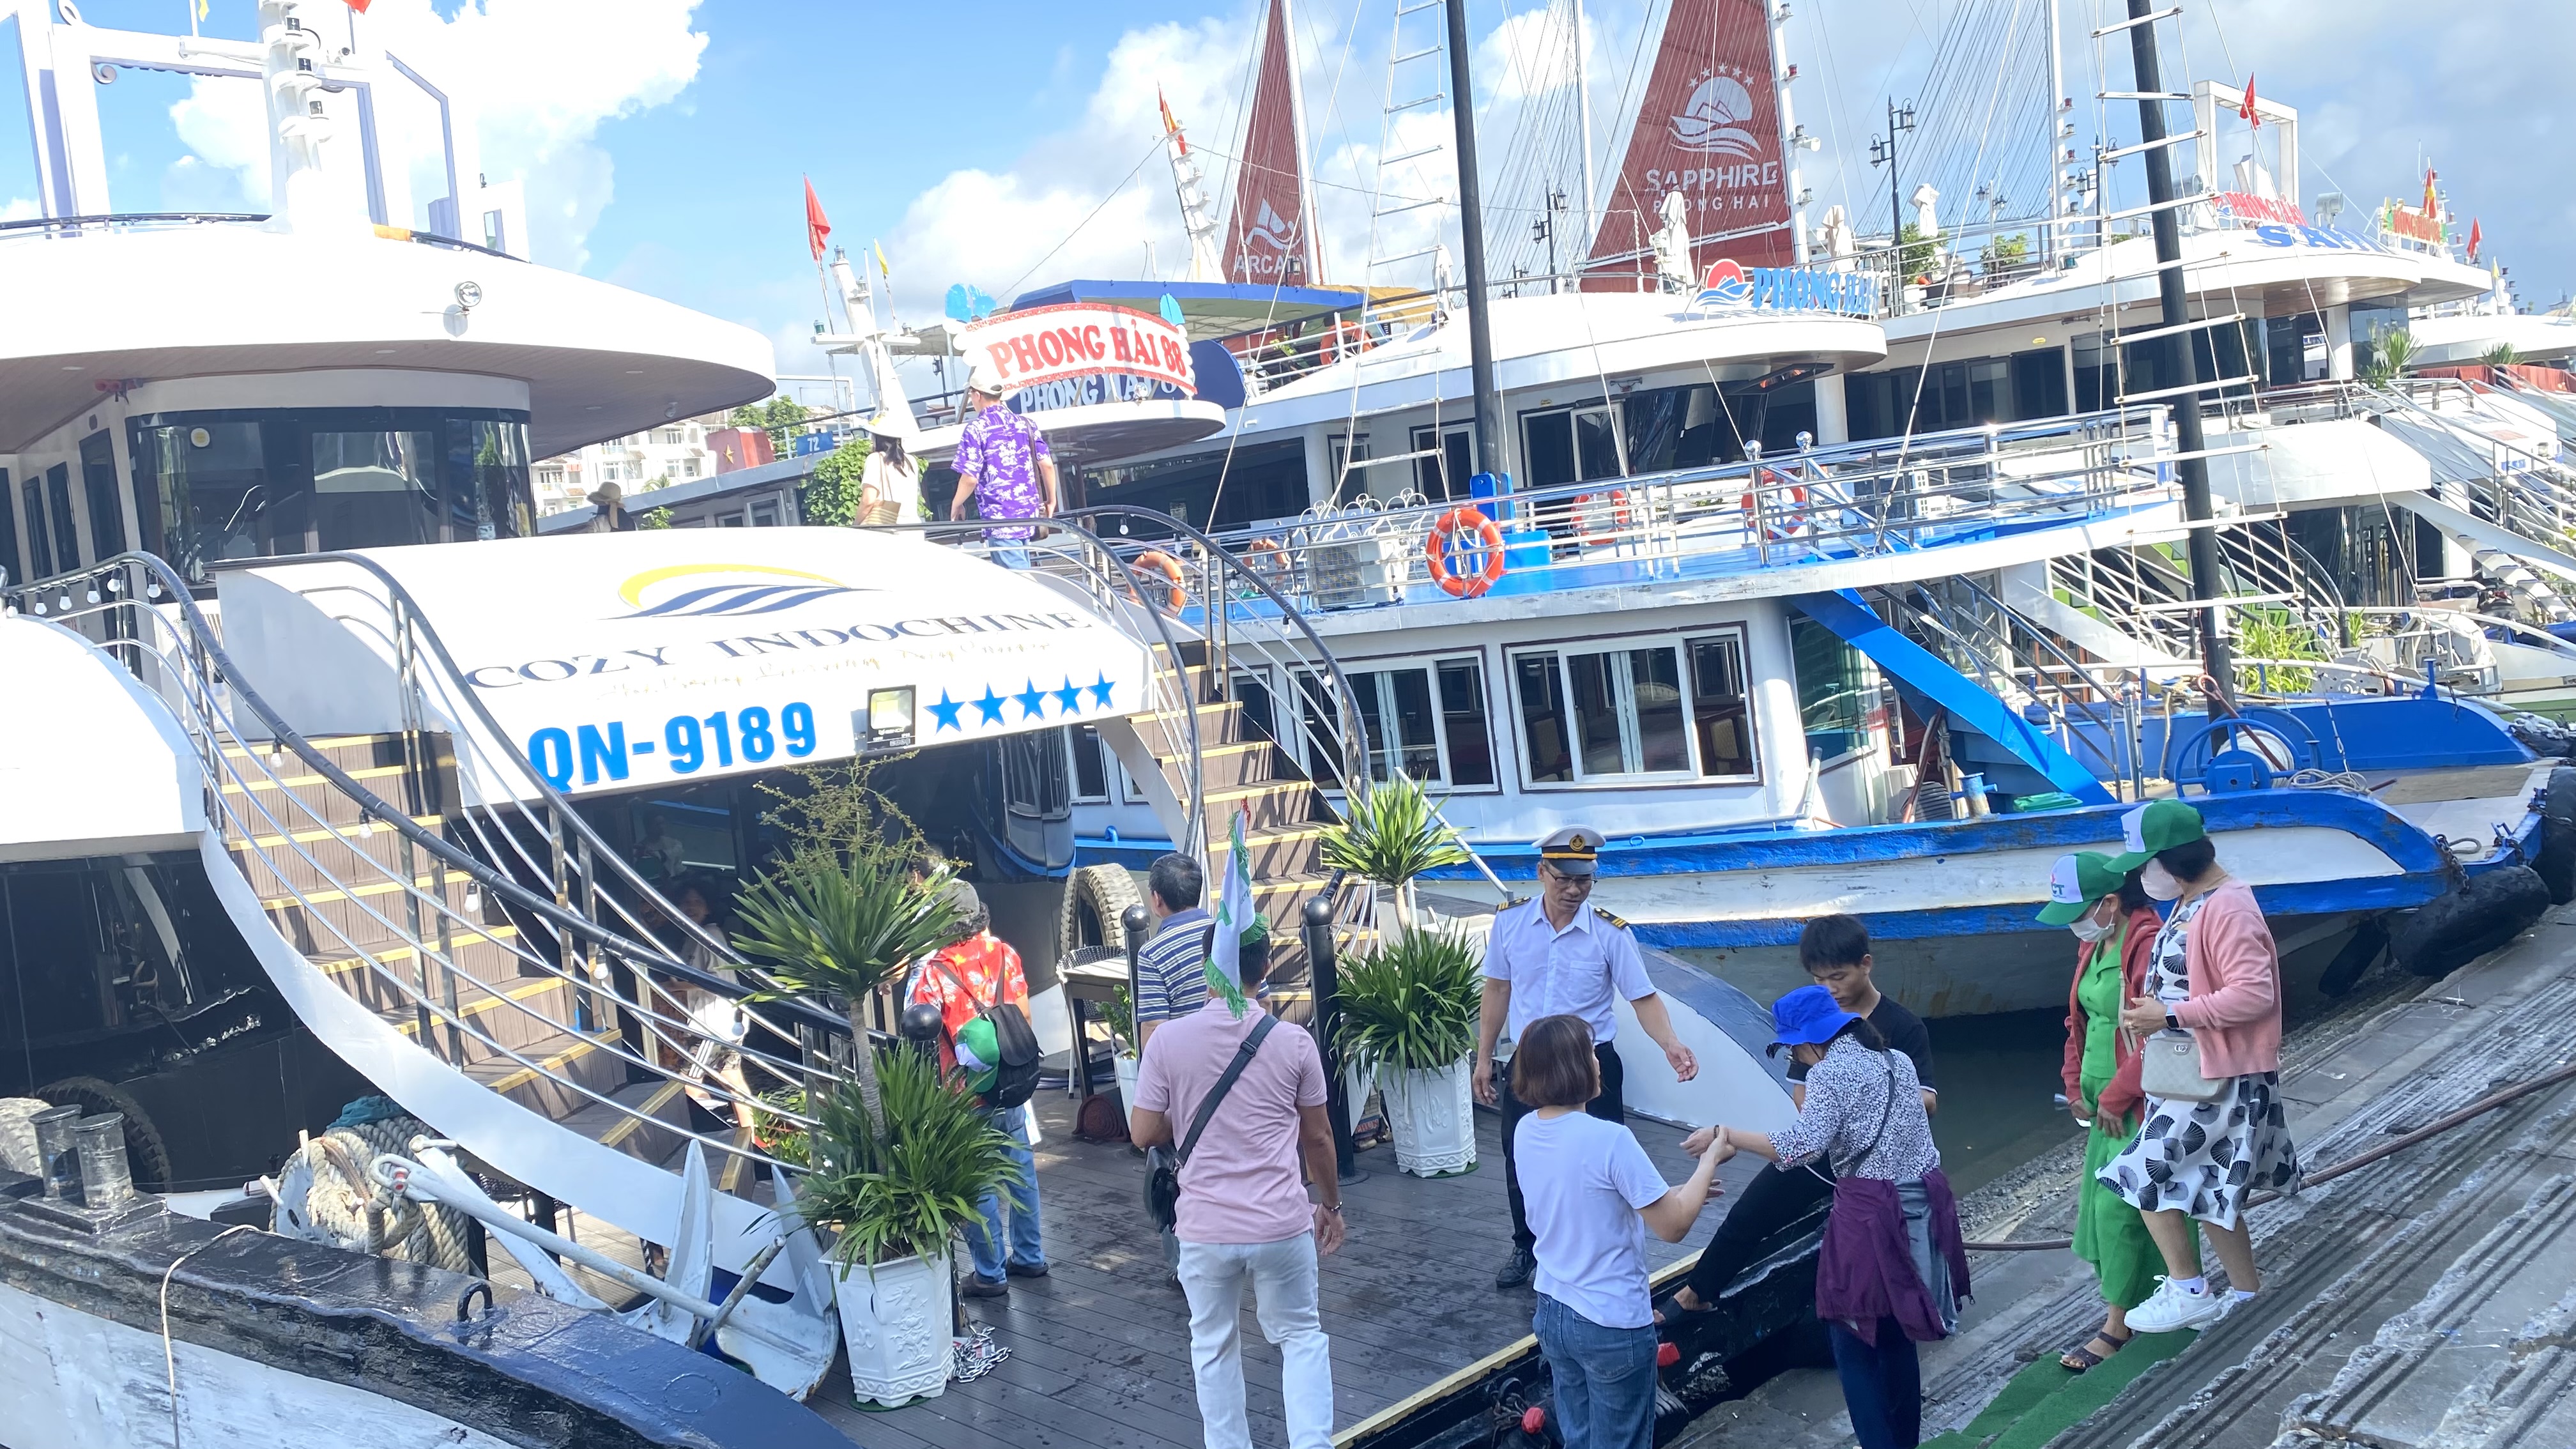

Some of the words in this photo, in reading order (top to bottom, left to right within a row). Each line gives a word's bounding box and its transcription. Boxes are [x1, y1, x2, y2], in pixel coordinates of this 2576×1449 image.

[1653, 197, 1723, 213] PONG
[1733, 194, 1768, 210] HAI
[1751, 267, 1841, 312] PHONG
[986, 325, 1105, 378] PHONG
[1110, 319, 1160, 367] HẢI
[1160, 335, 1186, 377] 88
[807, 436, 820, 452] 72
[464, 646, 676, 688] COZY
[705, 613, 1092, 657] INDOCHINE
[528, 702, 816, 794] QN-9189
